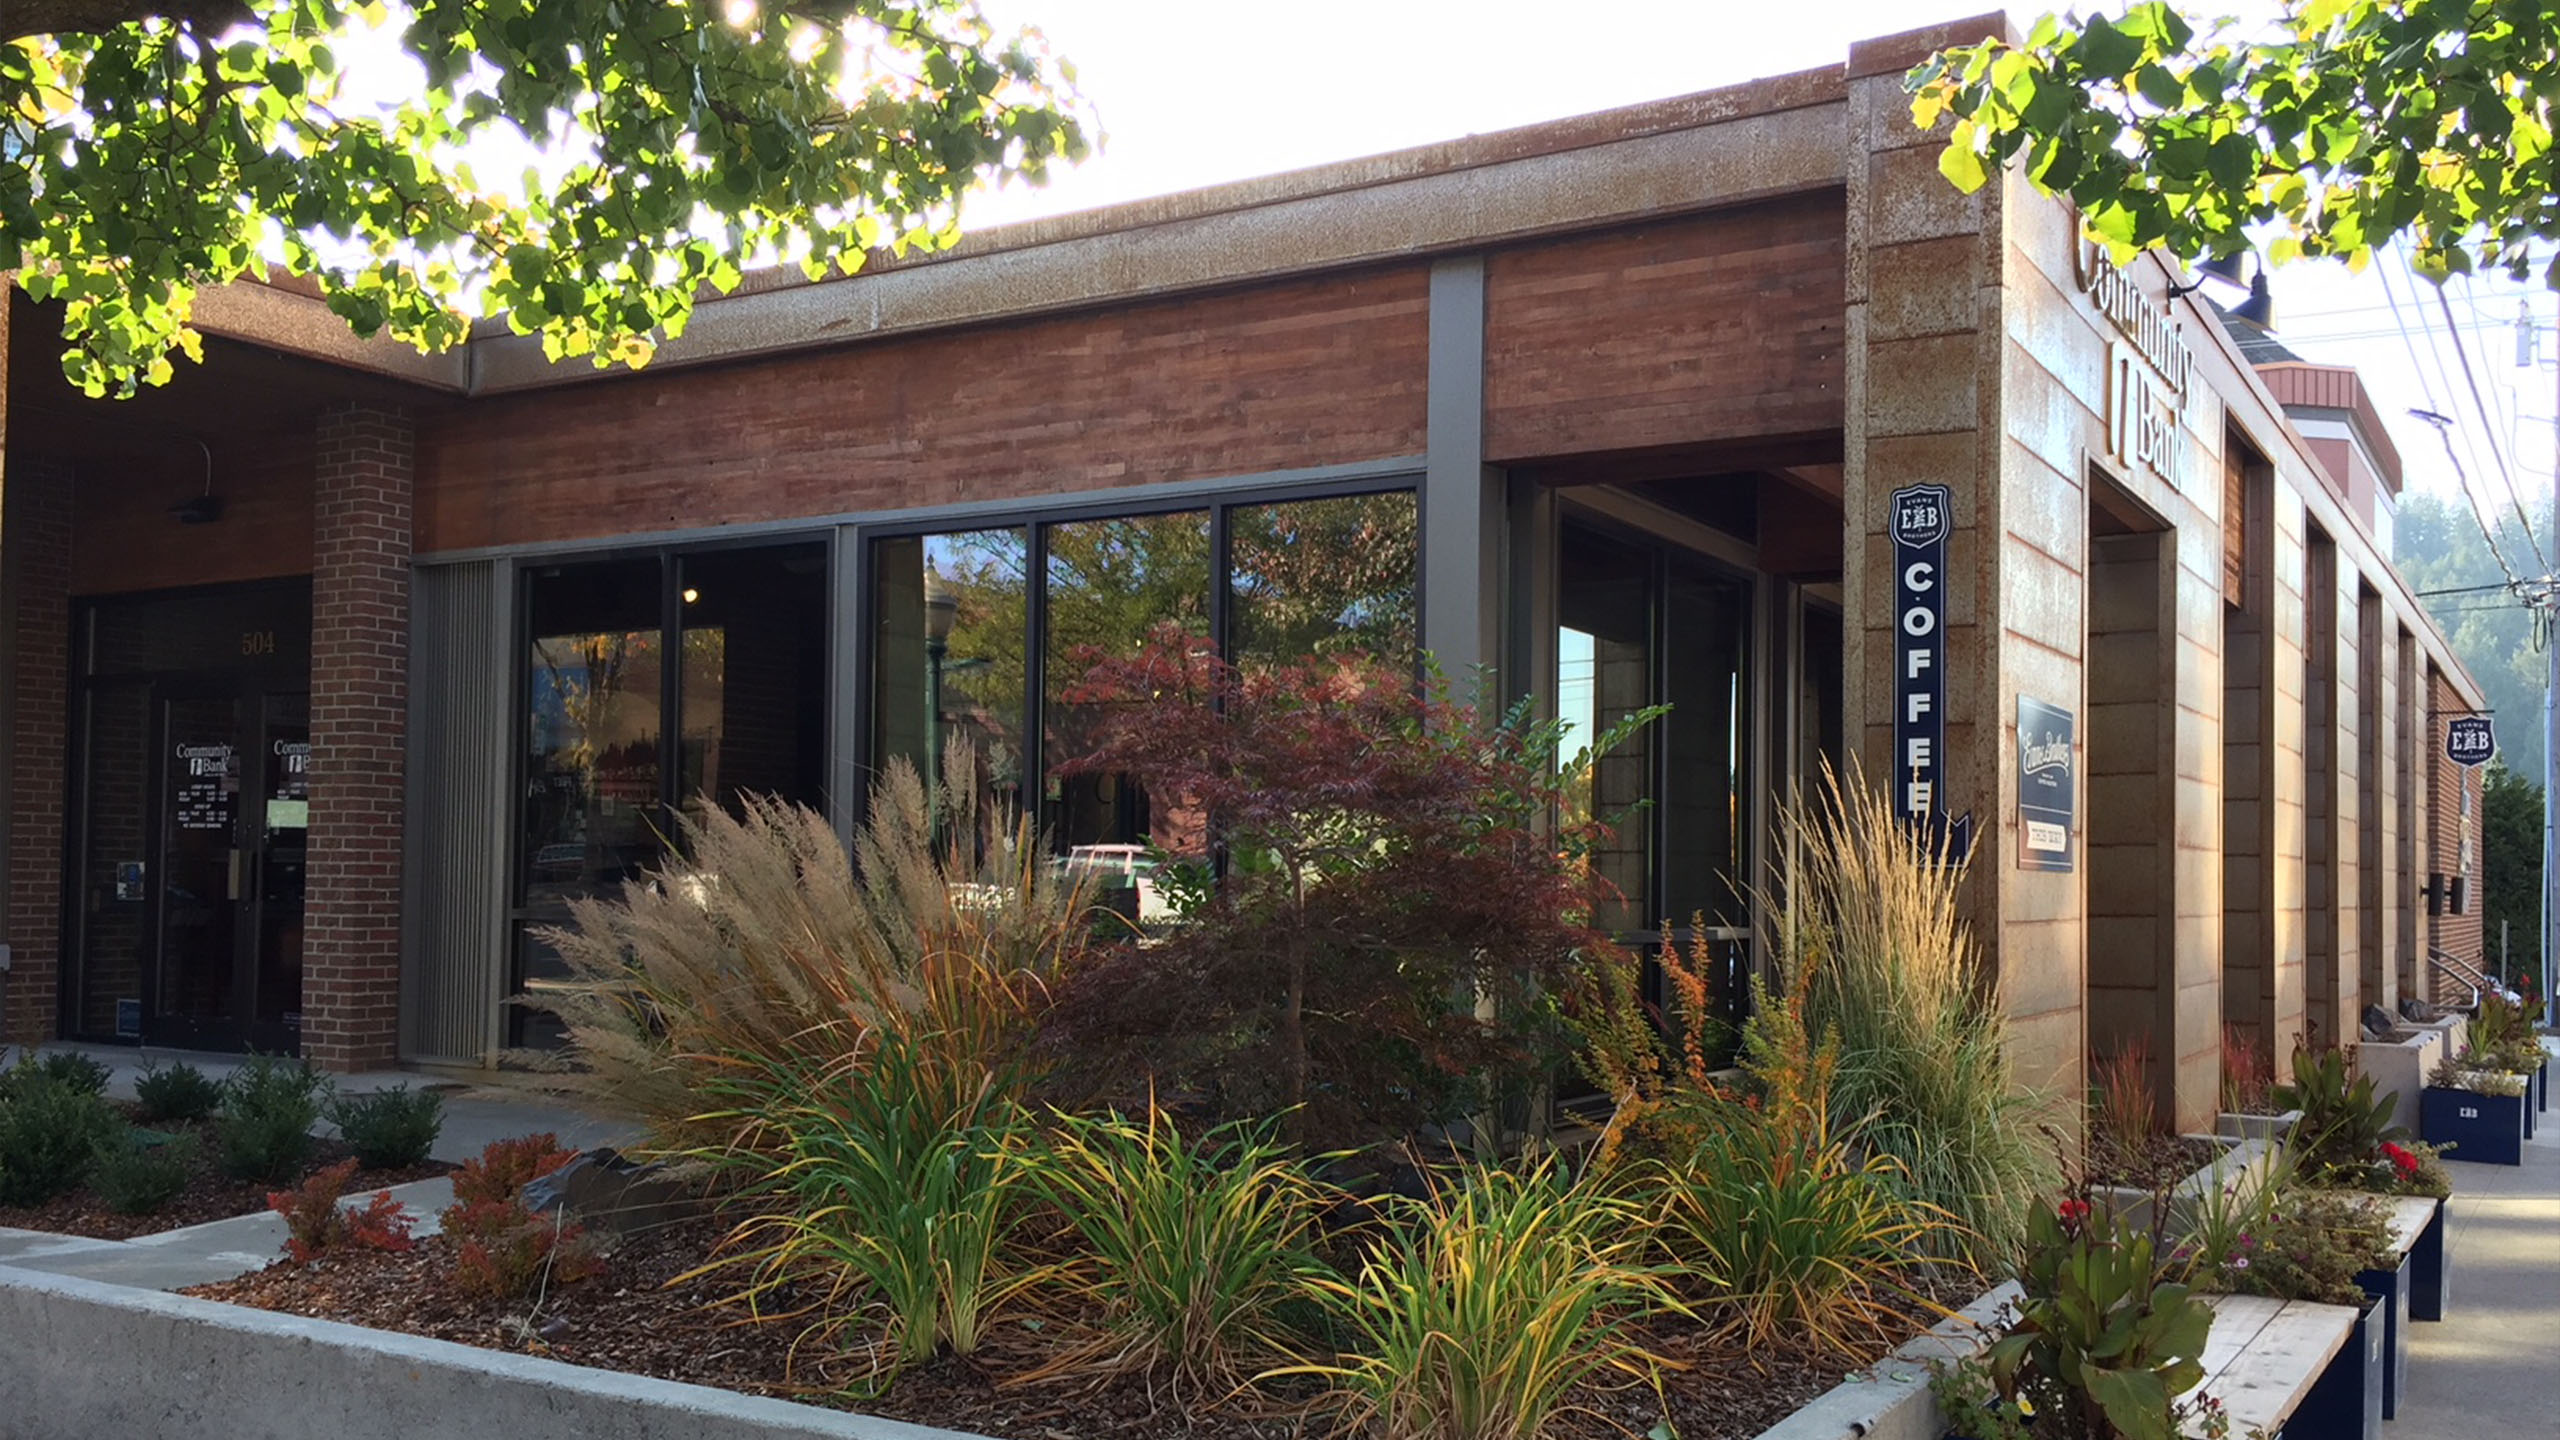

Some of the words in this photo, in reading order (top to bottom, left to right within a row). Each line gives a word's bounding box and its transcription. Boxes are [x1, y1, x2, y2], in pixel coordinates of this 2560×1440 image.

[2138, 371, 2184, 493] Bank
[1906, 498, 1932, 506] EVANS
[242, 631, 275, 656] 504
[1903, 562, 1935, 812] COFFEE
[176, 741, 234, 760] Community
[203, 757, 229, 773] Bank
